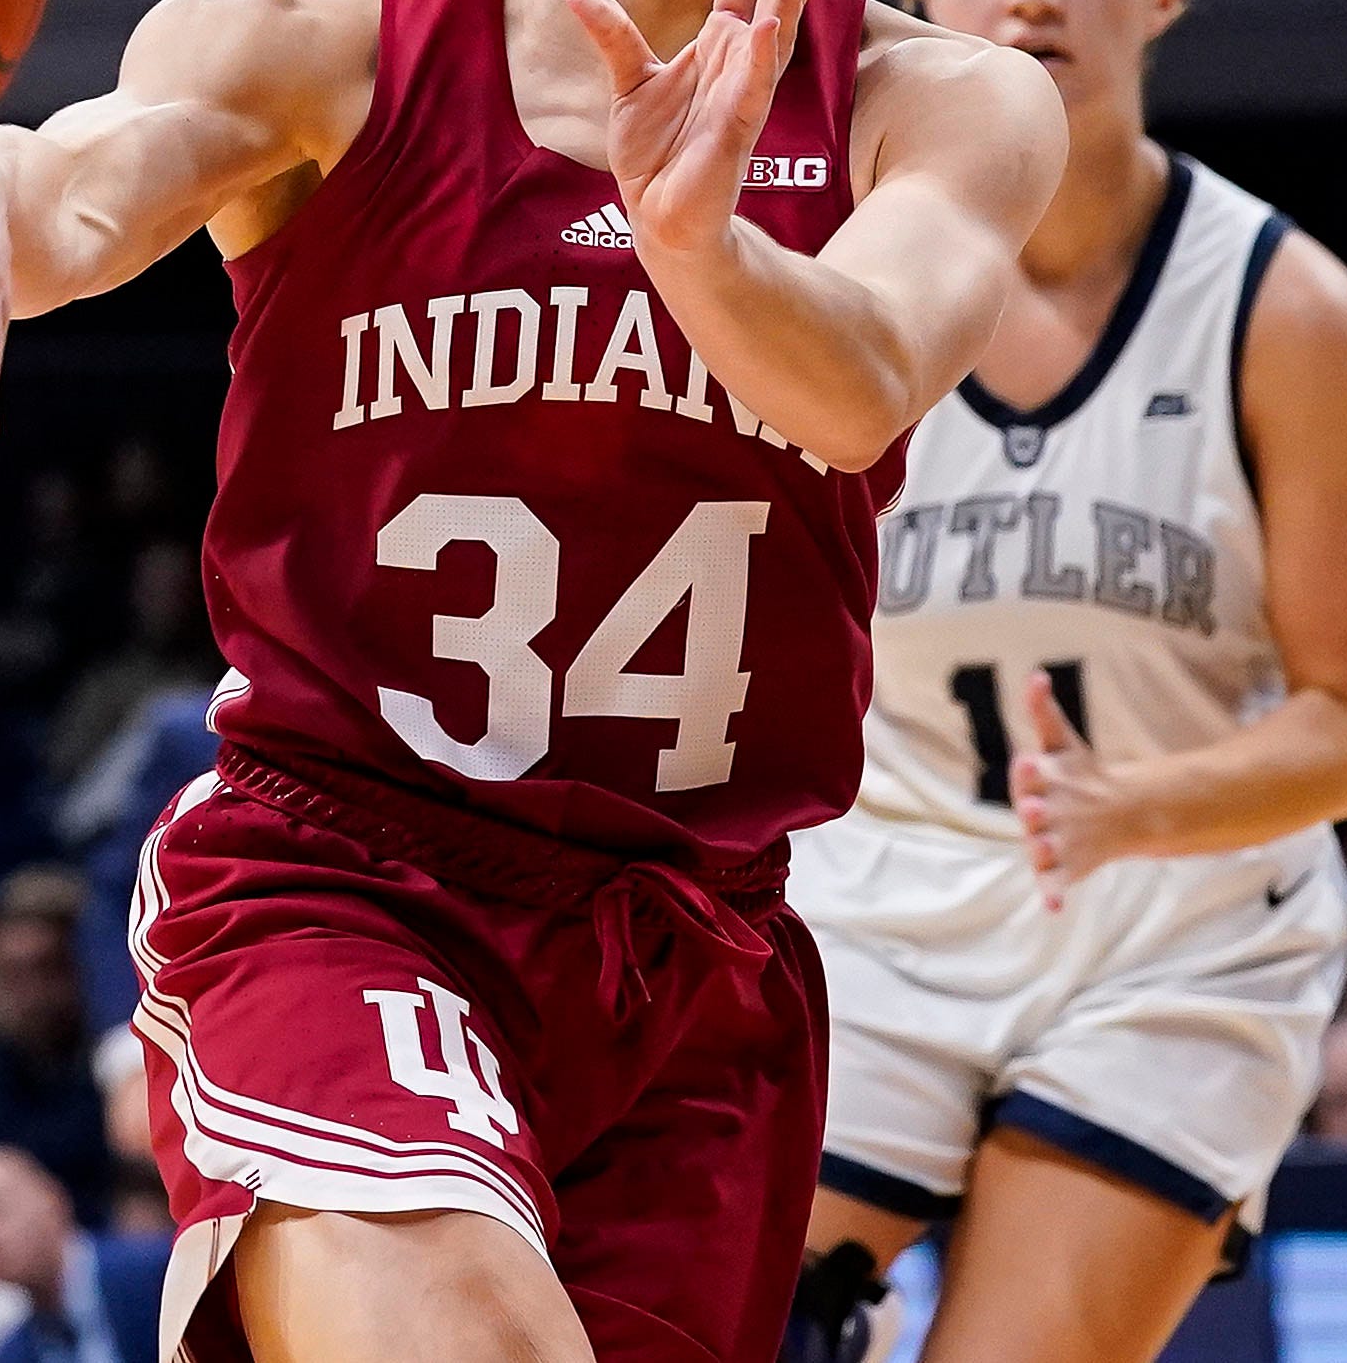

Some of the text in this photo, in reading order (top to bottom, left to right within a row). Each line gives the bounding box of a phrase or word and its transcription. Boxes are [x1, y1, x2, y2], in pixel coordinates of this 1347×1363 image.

[560, 227, 637, 249] adida
[333, 286, 829, 477] INDIA
[377, 494, 771, 792] 34
[877, 488, 1219, 639] UTLER
